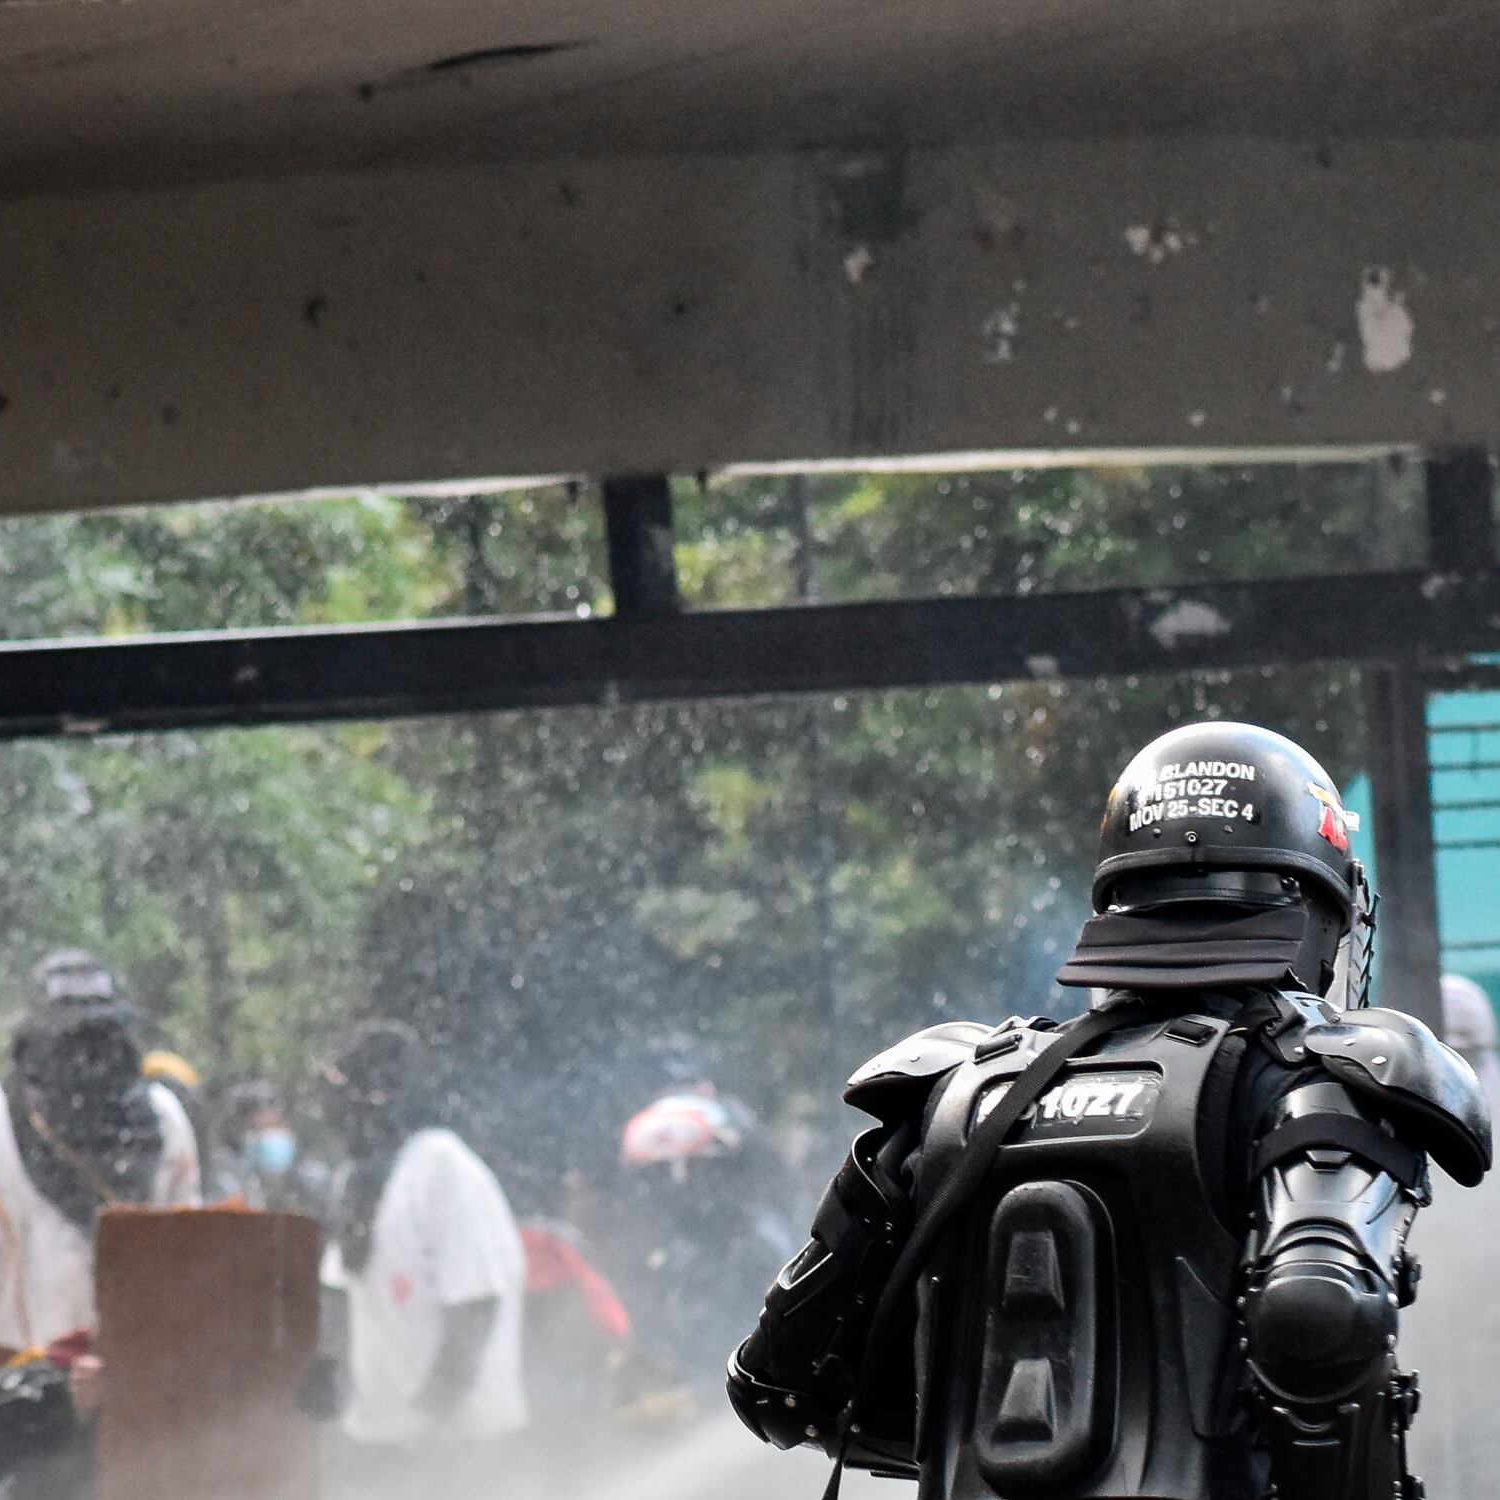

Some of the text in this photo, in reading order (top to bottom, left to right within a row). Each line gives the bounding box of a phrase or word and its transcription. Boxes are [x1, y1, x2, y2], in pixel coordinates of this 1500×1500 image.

[1159, 761, 1256, 781] BLANDON
[1241, 803, 1254, 821] 4
[976, 1082, 1145, 1123] 1027
